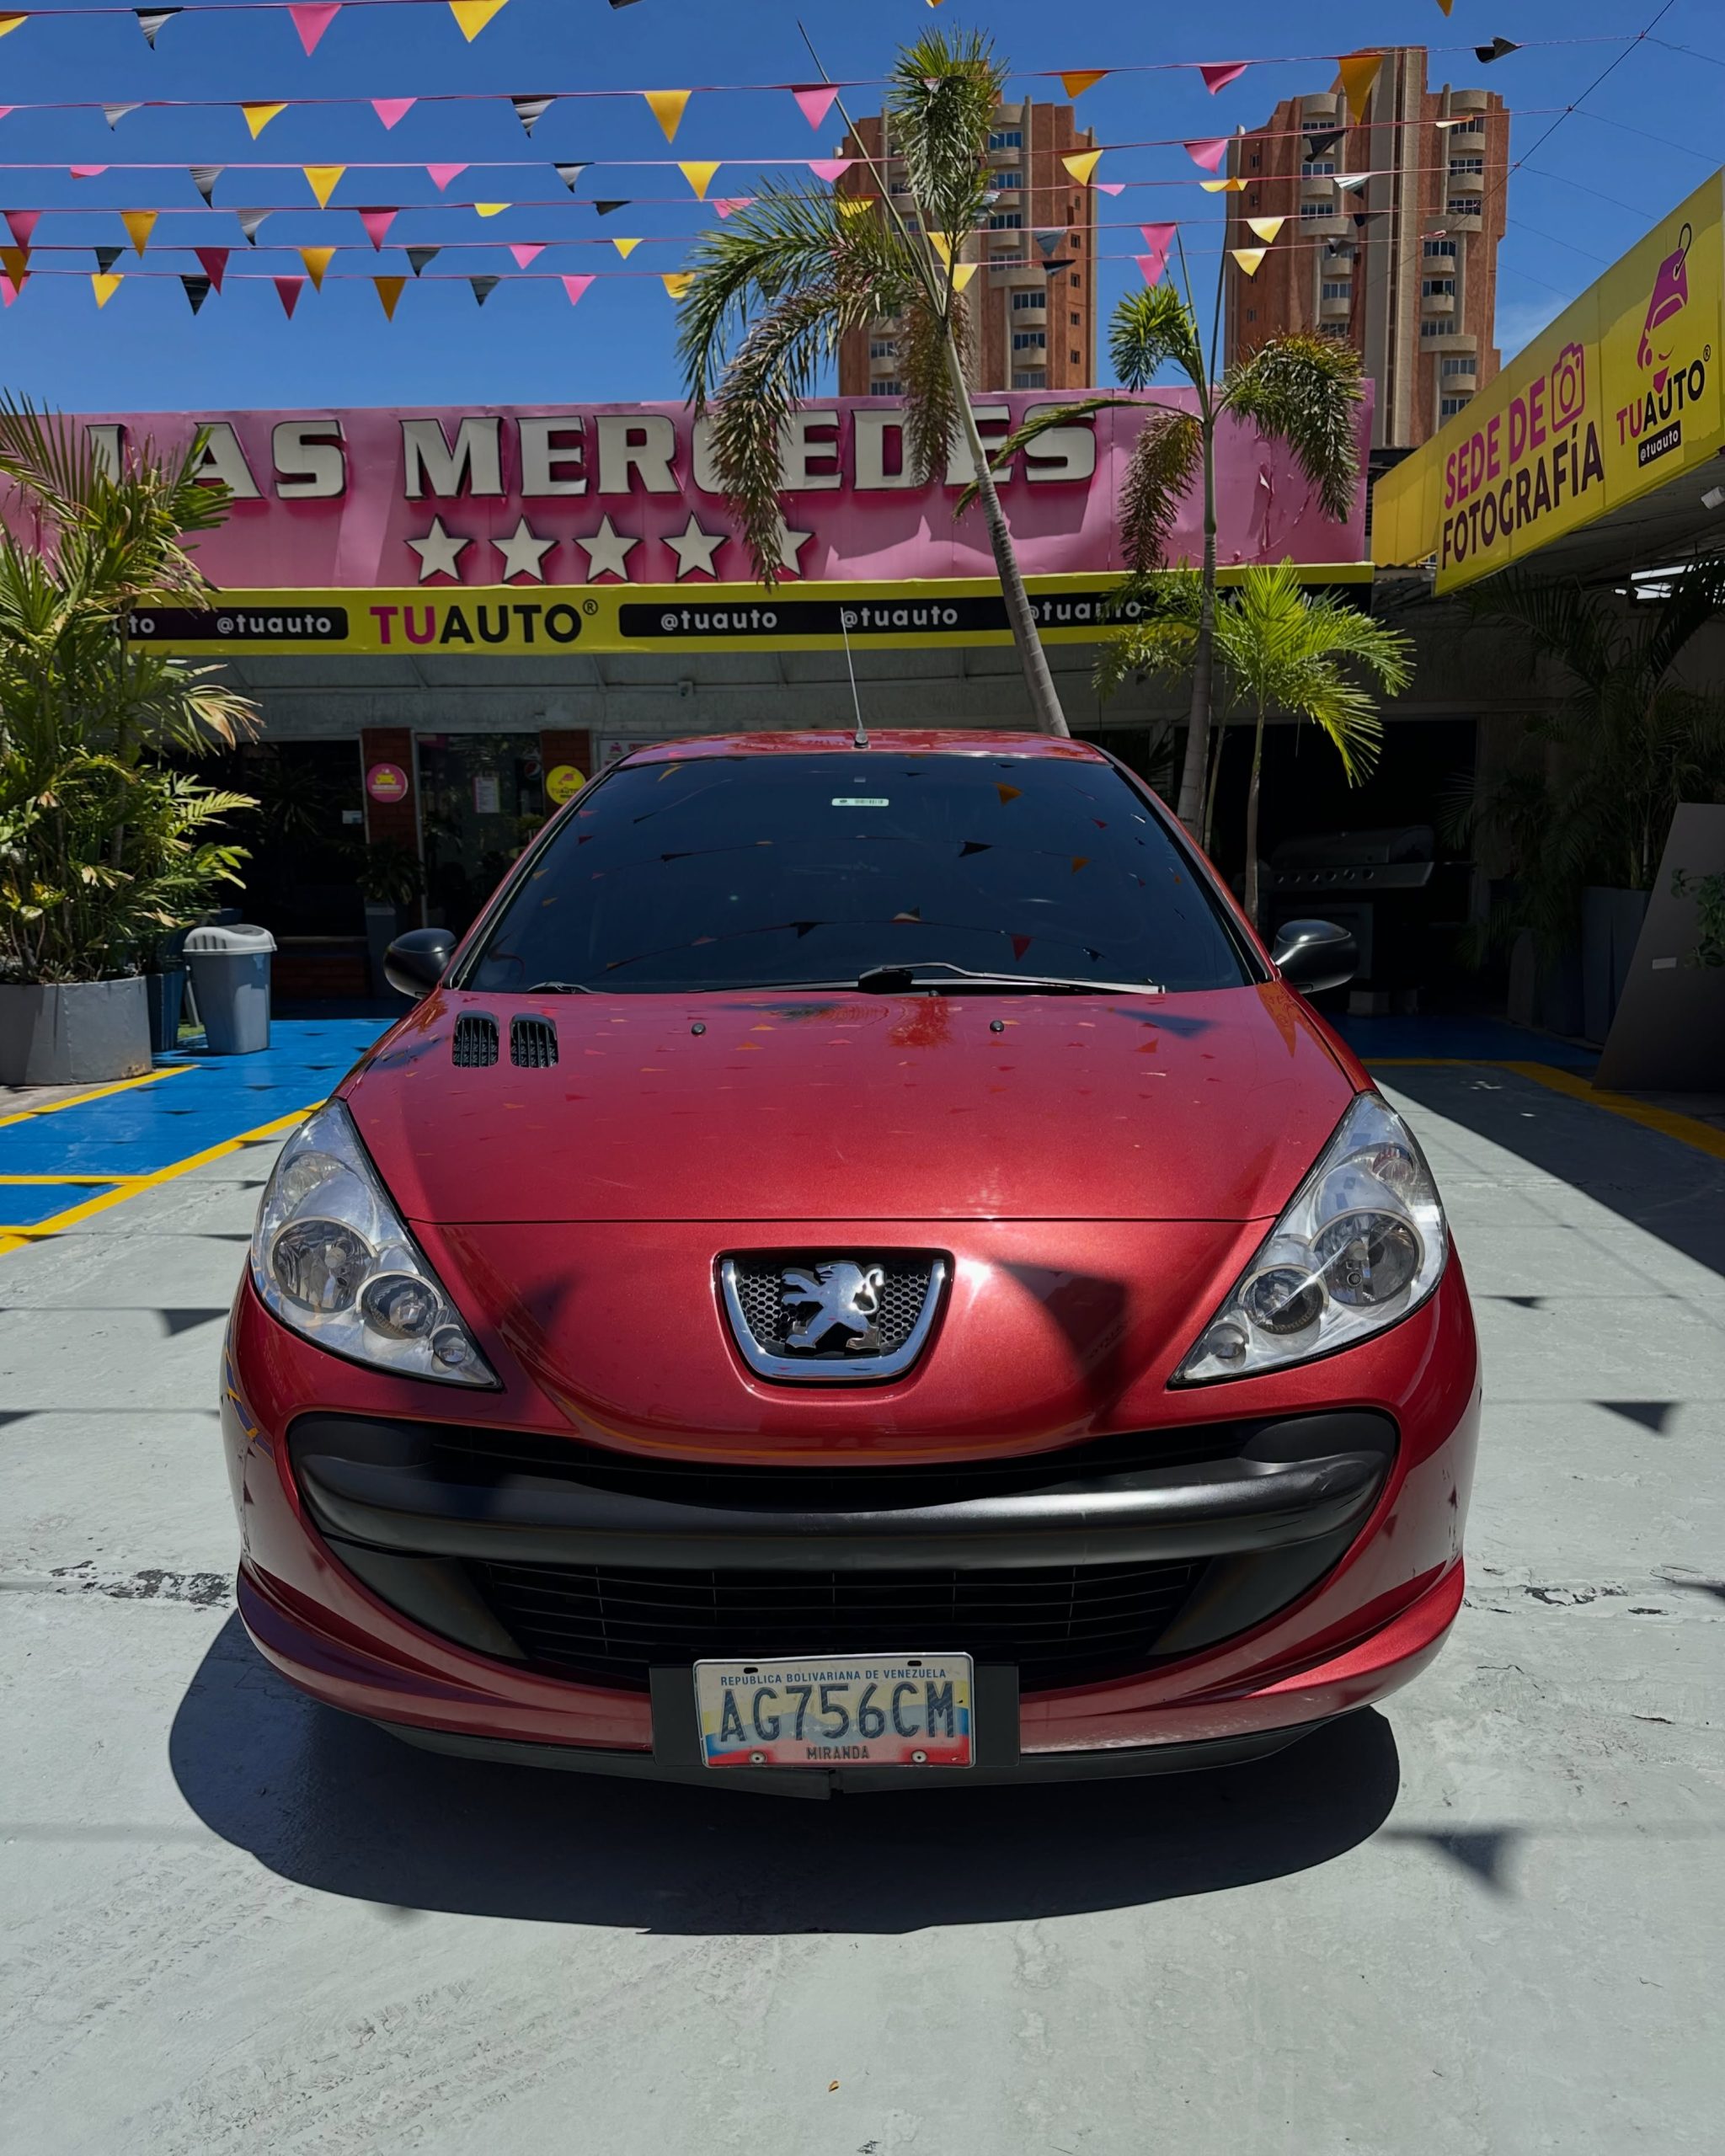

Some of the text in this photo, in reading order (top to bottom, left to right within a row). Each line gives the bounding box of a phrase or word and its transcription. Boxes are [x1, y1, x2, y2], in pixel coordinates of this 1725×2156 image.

[1445, 376, 1546, 510] SEDE DE
[1640, 430, 1679, 461] @tuauto
[1442, 420, 1605, 570] FOTOGRAFÍA
[216, 613, 332, 634] @tuauto
[660, 610, 777, 631] @tuauto
[841, 607, 959, 628] @tuauto
[720, 1668, 946, 1685] REPUBLICA BOLIVARIANA DE VENEZUELA
[720, 1681, 955, 1742] AG756CM
[805, 1745, 870, 1761] MIRANDA
